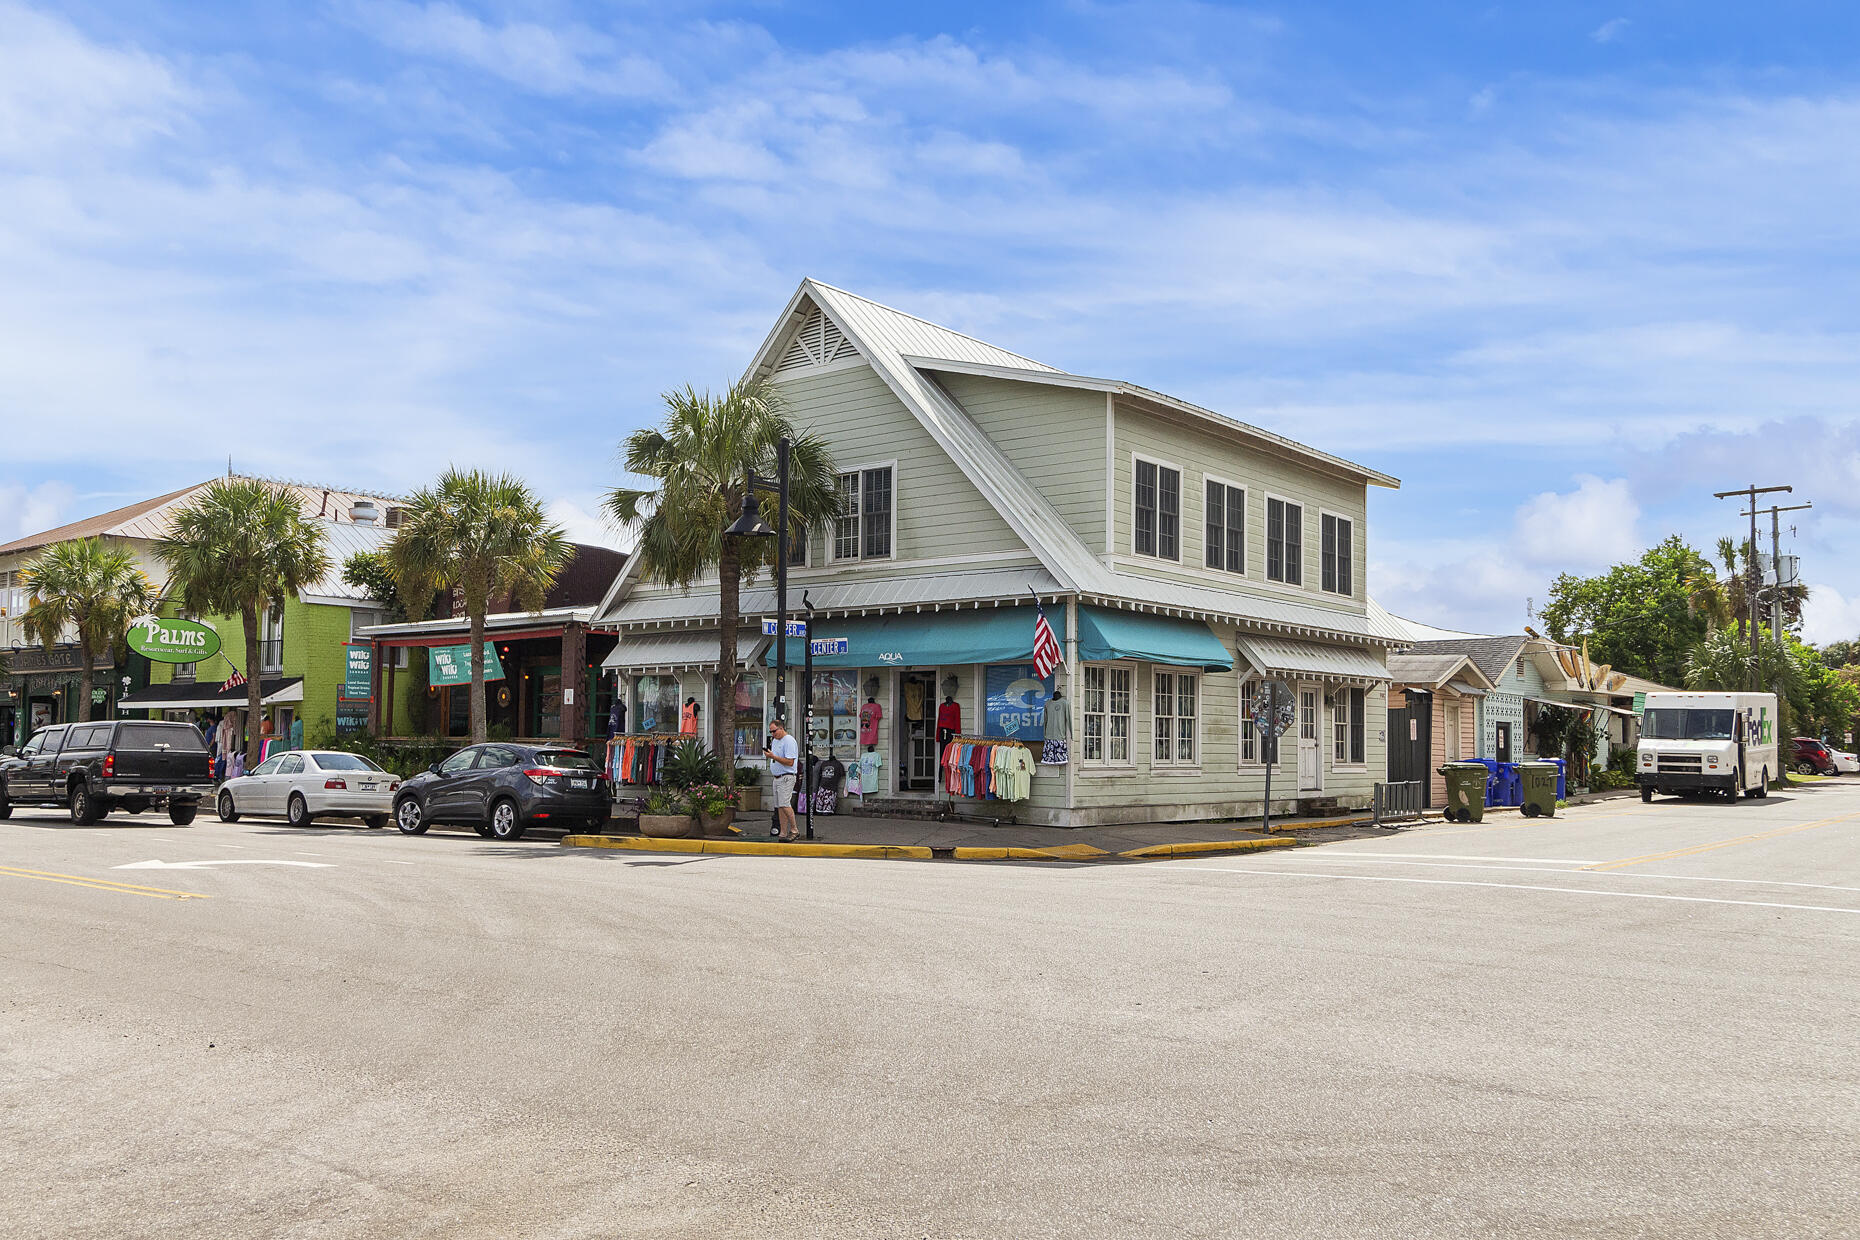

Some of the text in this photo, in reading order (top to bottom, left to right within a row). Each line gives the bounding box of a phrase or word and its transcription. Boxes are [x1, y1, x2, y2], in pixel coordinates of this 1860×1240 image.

[763, 623, 769, 634] W
[771, 623, 798, 636] CPER
[813, 641, 839, 654] CENTER
[879, 652, 904, 661] AQUA
[1747, 706, 1772, 746] FedEx
